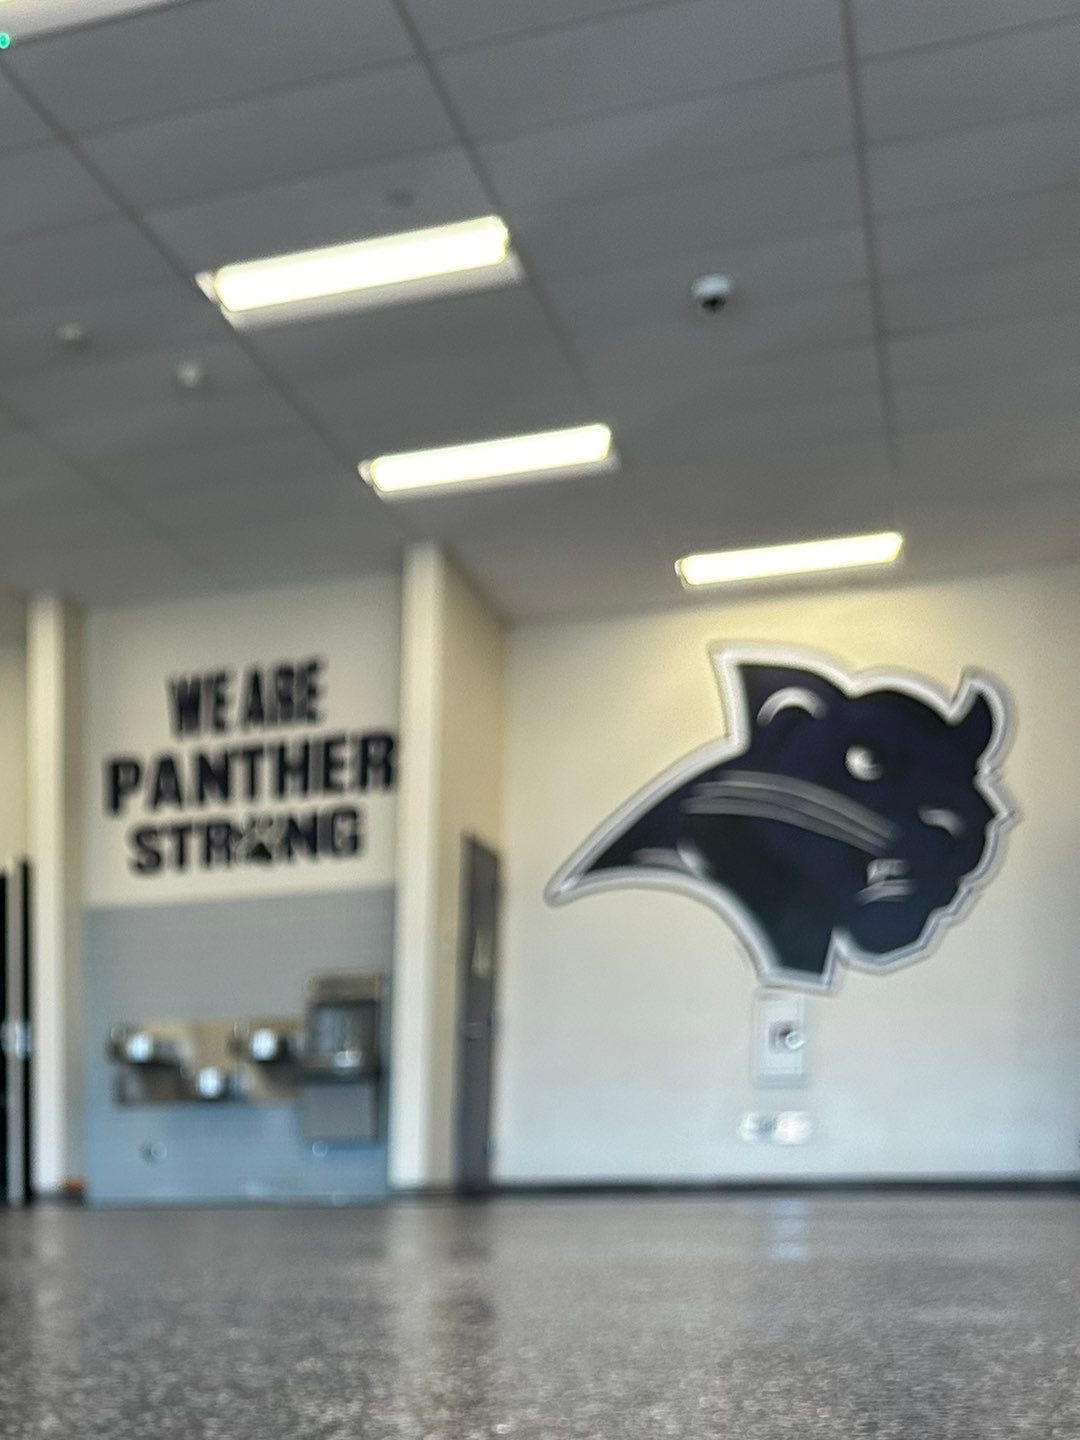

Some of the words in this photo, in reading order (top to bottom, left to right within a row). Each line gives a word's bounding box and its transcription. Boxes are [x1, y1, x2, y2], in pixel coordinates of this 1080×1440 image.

[167, 670, 227, 738] WE
[241, 656, 326, 729] ARE
[104, 730, 398, 820] PANTHER
